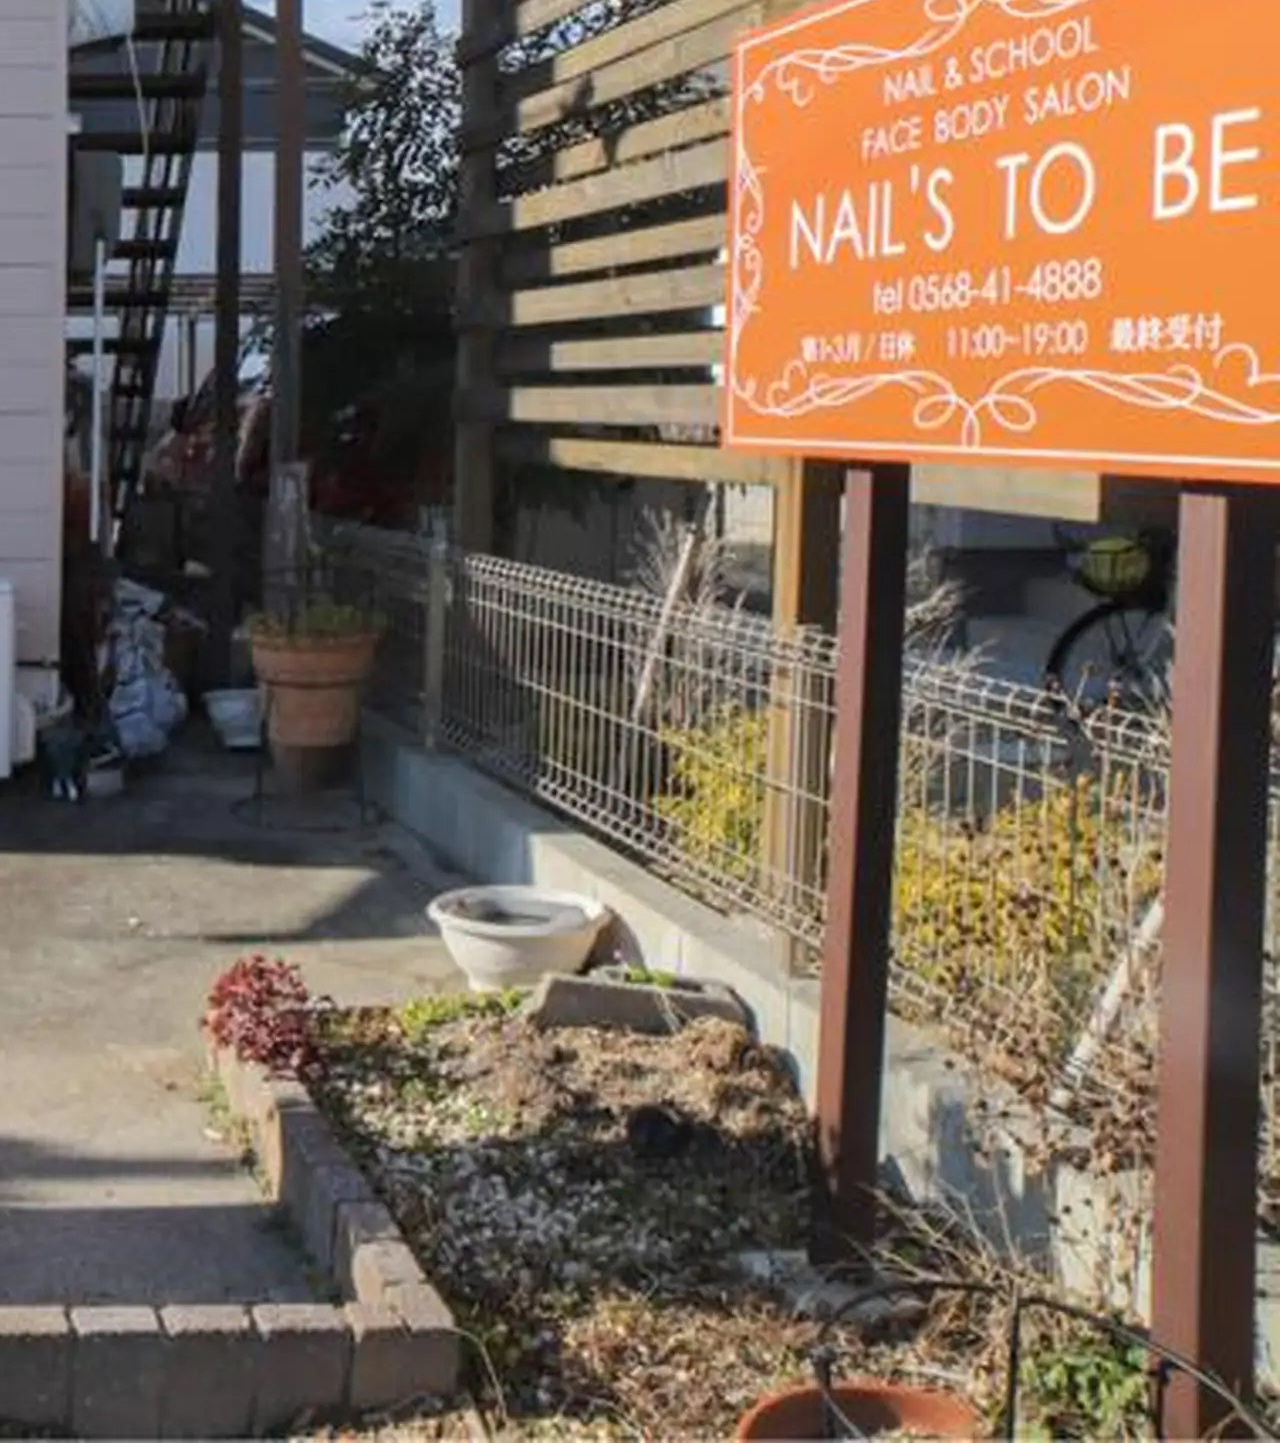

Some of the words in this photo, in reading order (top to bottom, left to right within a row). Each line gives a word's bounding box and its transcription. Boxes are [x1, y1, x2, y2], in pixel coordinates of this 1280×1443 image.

[882, 71, 938, 107] NAIL
[944, 57, 964, 91] &
[968, 16, 1100, 85] SCHOOL
[861, 116, 924, 161] FACE
[933, 93, 1011, 145] BODY
[1023, 65, 1131, 125] SALON
[789, 163, 955, 270] NAIL'S
[996, 141, 1096, 241] TO
[1152, 107, 1262, 220] BE
[873, 280, 903, 315] tel
[907, 257, 1103, 312] 0568-41-4888
[1108, 311, 1225, 352] 最終受付
